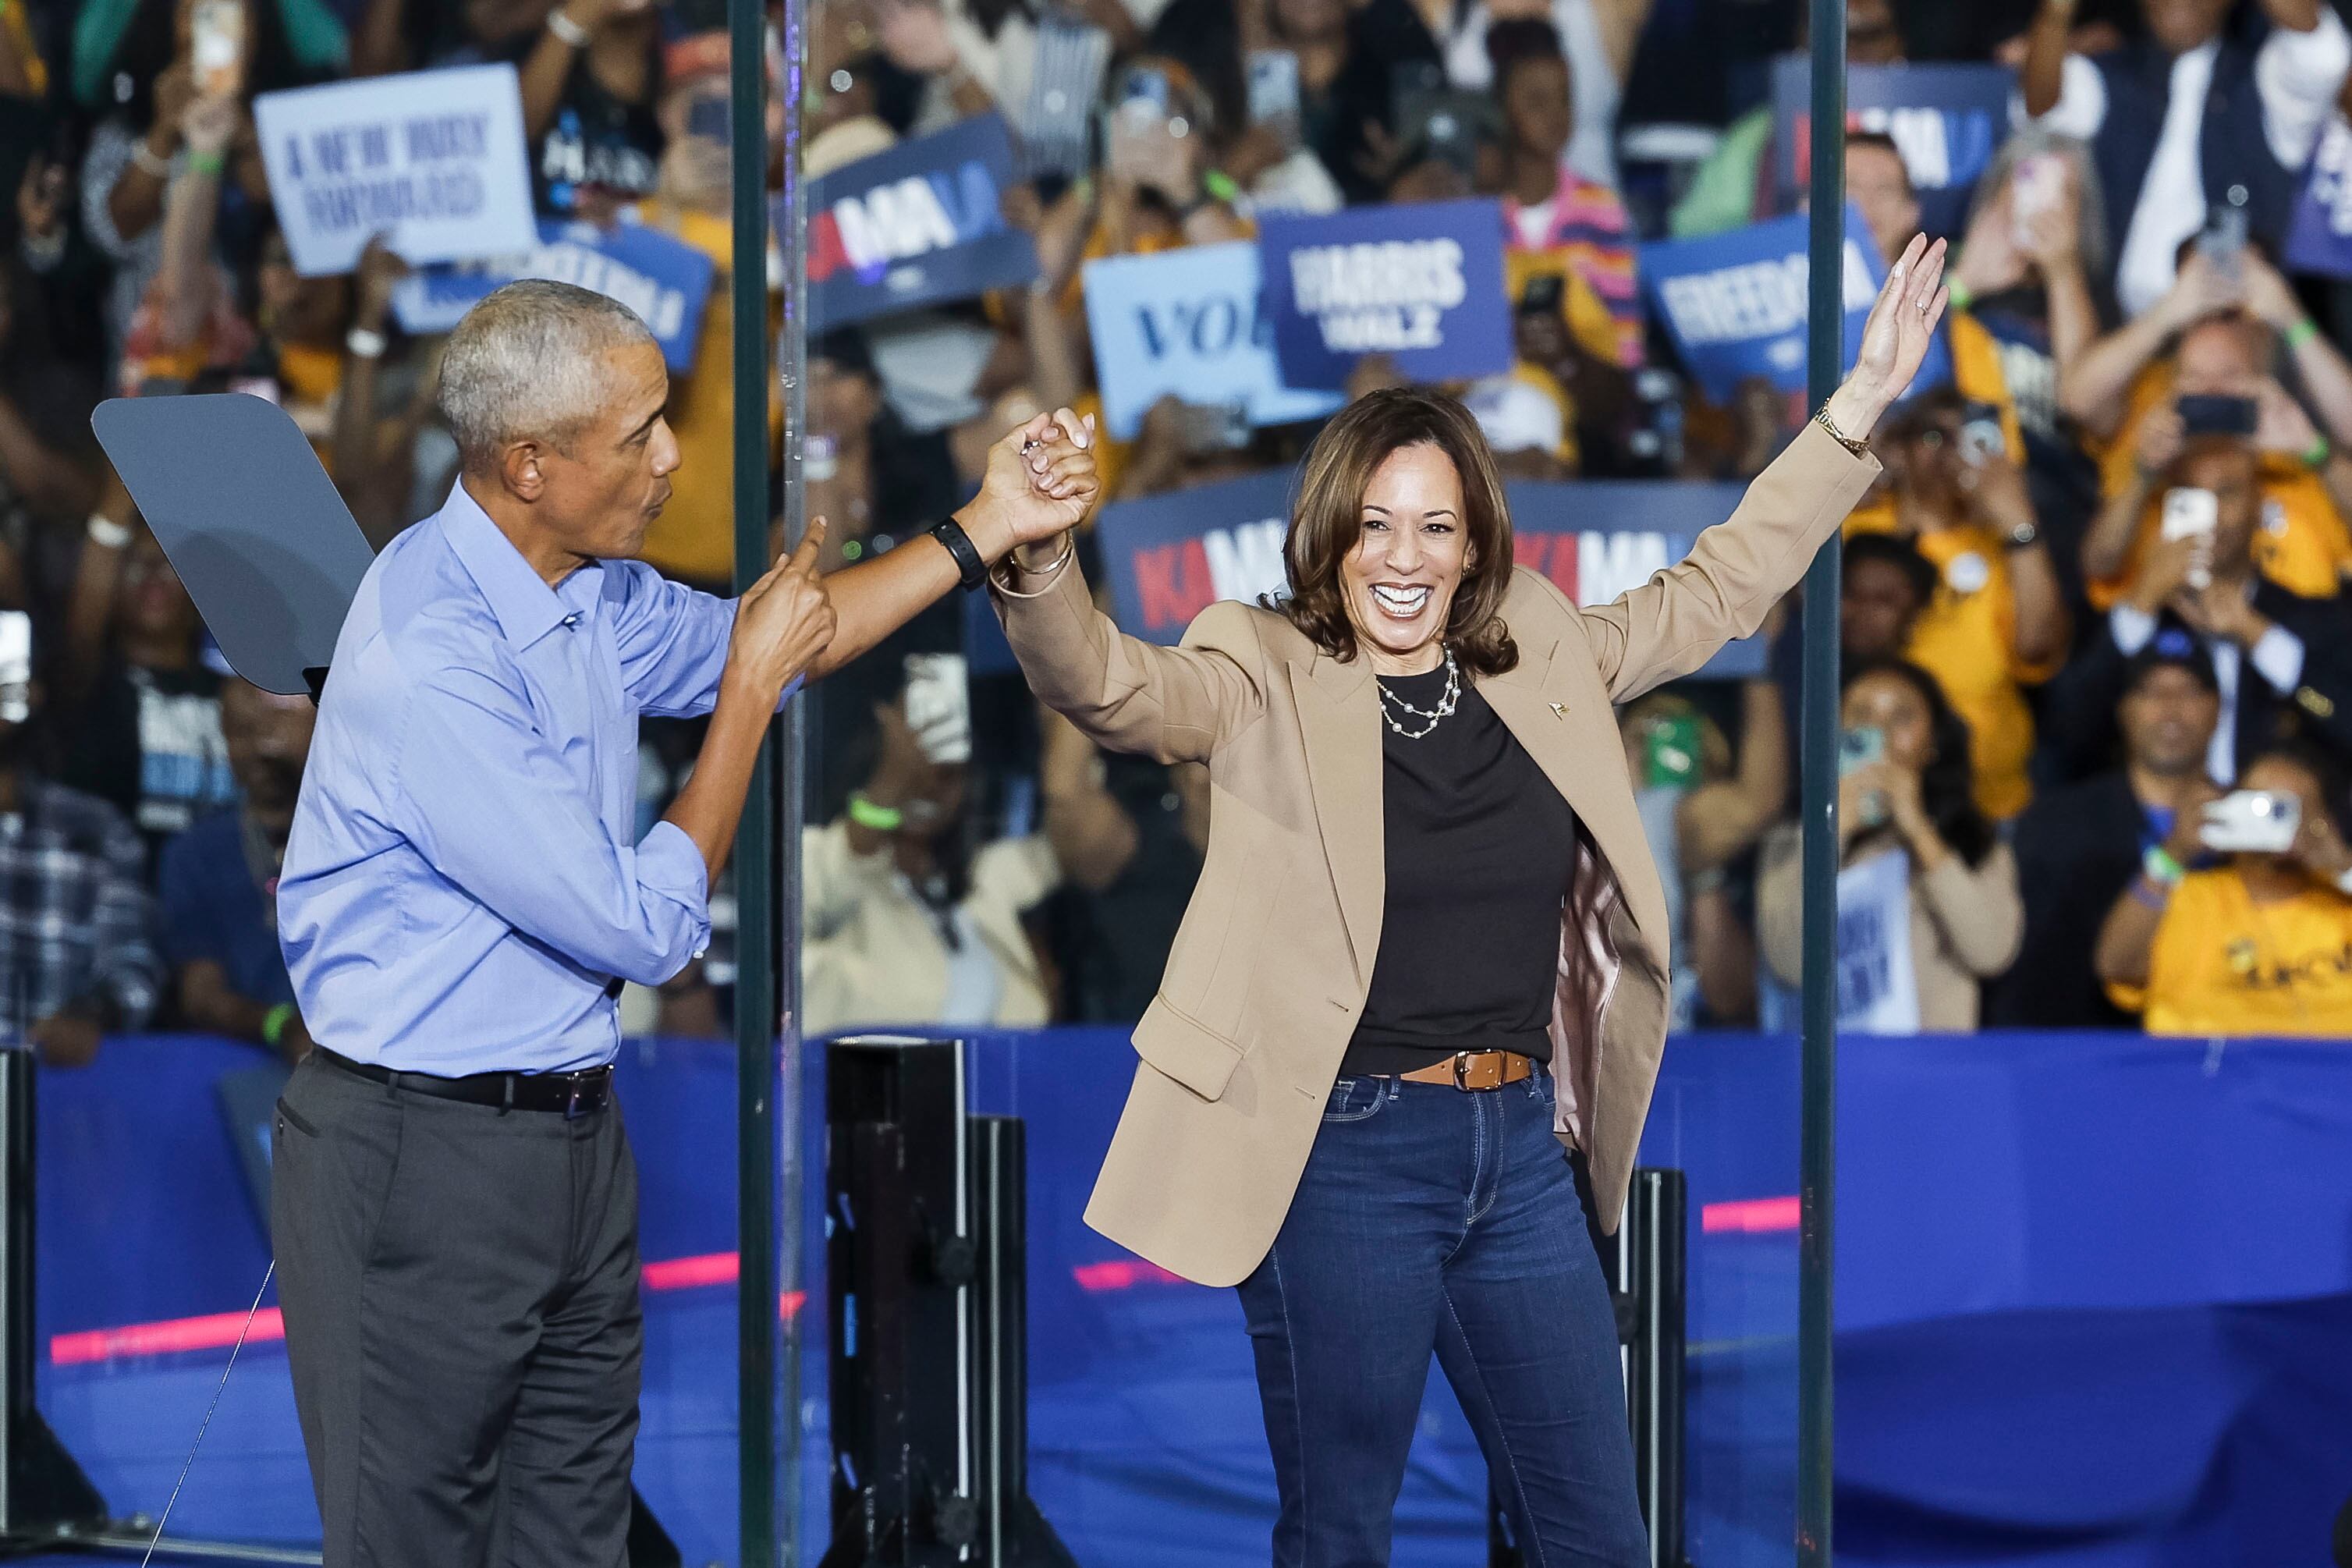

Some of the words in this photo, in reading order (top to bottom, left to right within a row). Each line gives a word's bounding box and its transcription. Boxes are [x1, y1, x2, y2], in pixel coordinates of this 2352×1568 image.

[284, 131, 304, 180] A
[312, 123, 390, 175] NEW
[406, 112, 490, 162] WAY
[1289, 237, 1467, 317] HARRIS
[1320, 306, 1443, 353] WALZ
